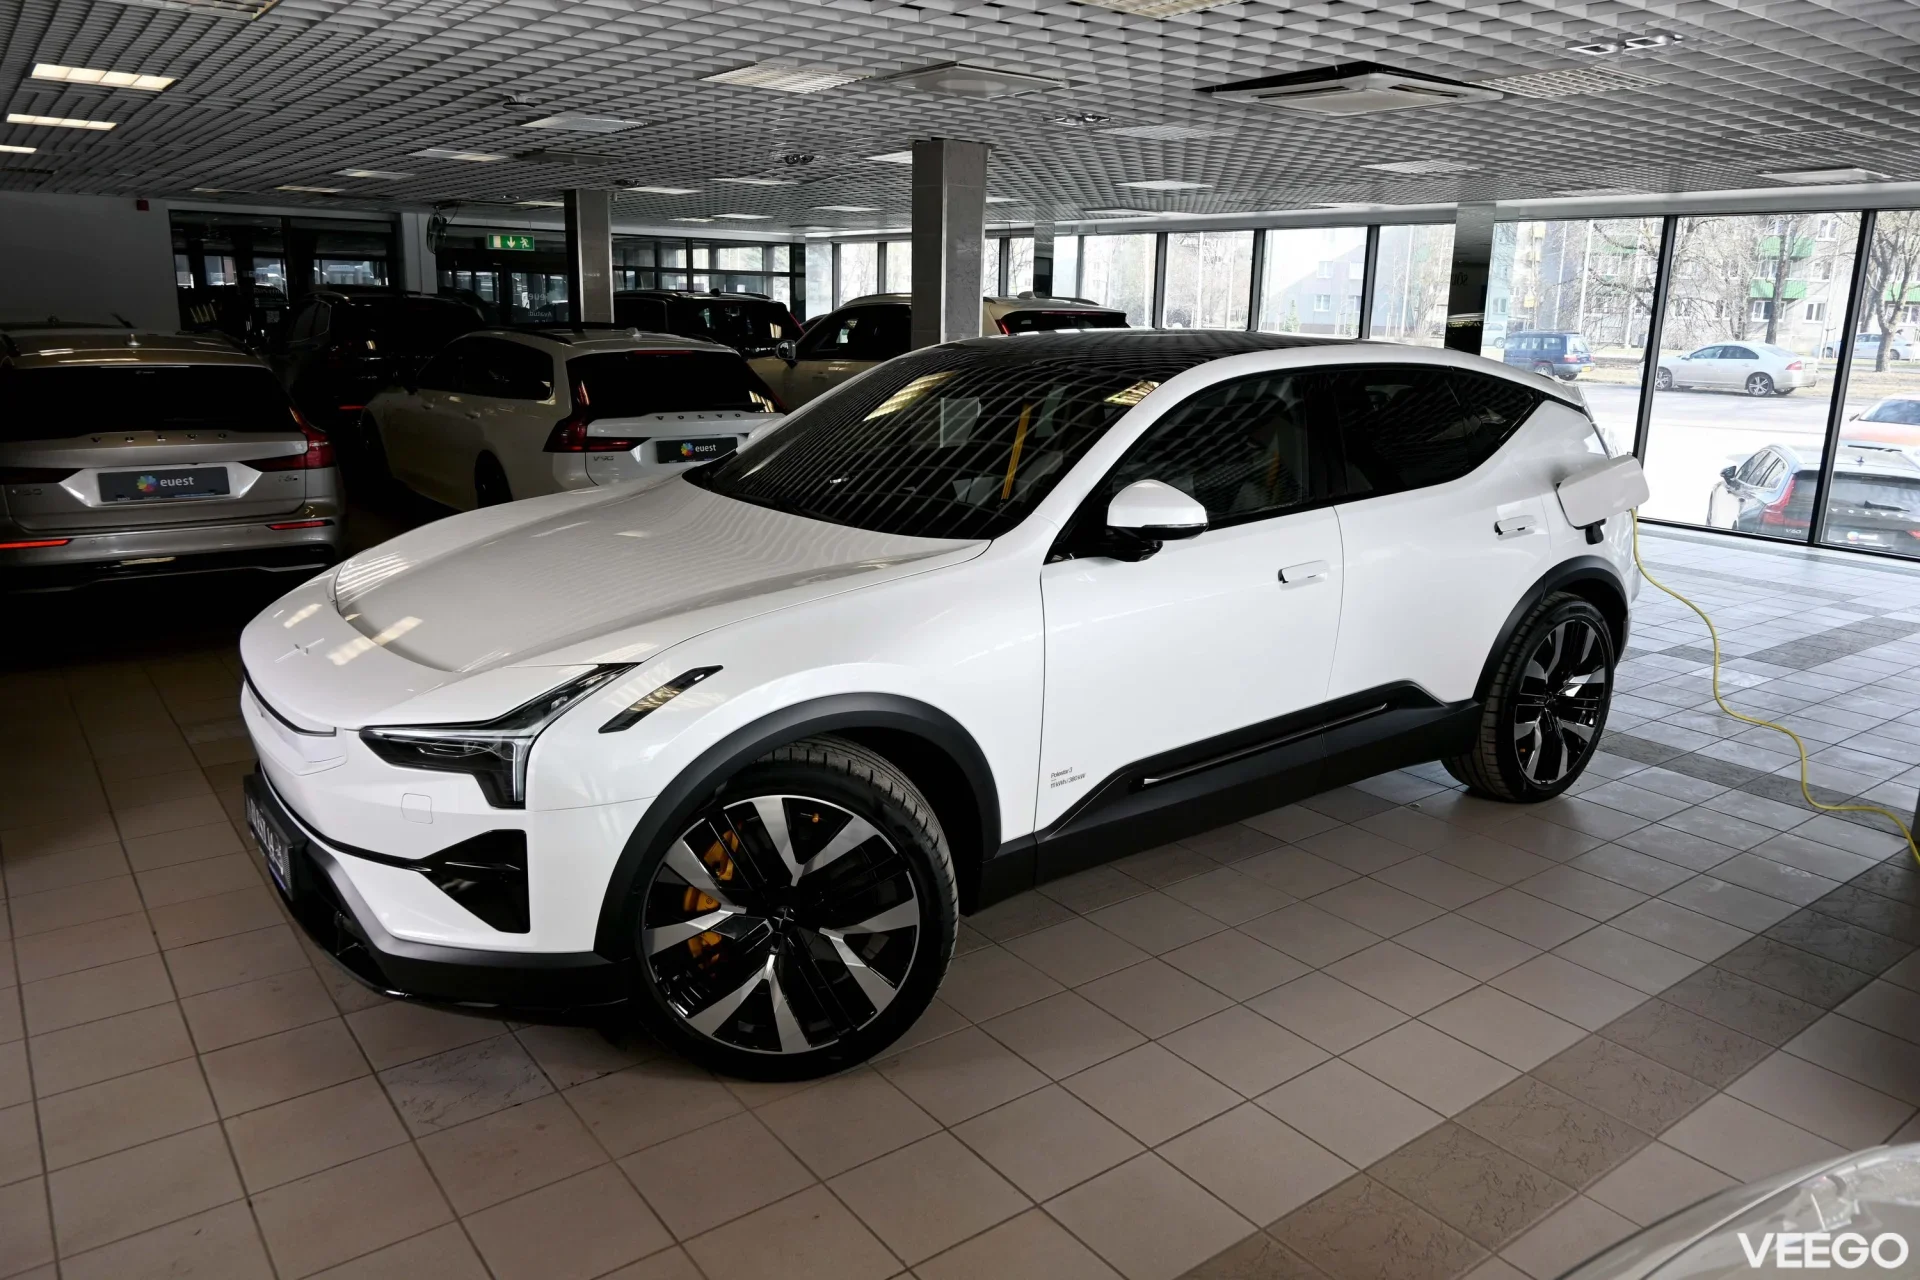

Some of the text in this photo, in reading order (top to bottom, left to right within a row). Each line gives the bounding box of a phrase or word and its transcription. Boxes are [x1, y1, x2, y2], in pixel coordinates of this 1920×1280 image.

[656, 413, 741, 421] VOLVO
[90, 433, 227, 443] VOLVO
[695, 444, 718, 453] euest
[159, 475, 195, 487] euest
[1831, 508, 1904, 518] VOLVO
